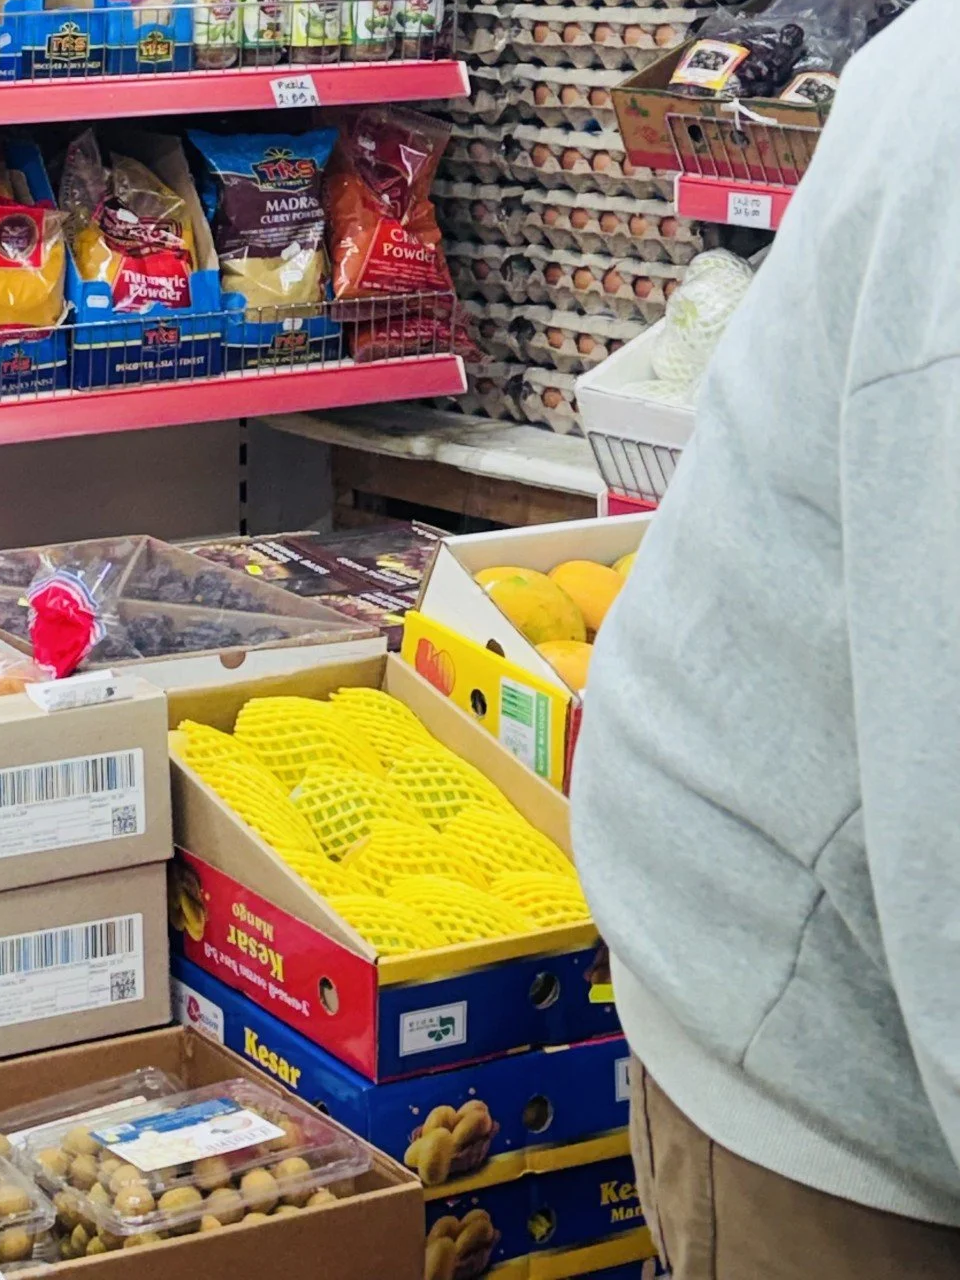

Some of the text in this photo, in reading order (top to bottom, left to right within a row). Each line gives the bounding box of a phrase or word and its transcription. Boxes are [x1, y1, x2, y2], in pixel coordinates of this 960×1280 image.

[52, 36, 87, 52] TRS
[260, 159, 317, 181] TRS
[122, 268, 187, 289] Turmeric
[130, 284, 182, 302] Powder
[146, 328, 179, 346] TRS
[1, 357, 32, 373] TRS
[231, 902, 275, 941] Mango
[227, 923, 285, 983] Kesar
[243, 1025, 302, 1090] Kesar
